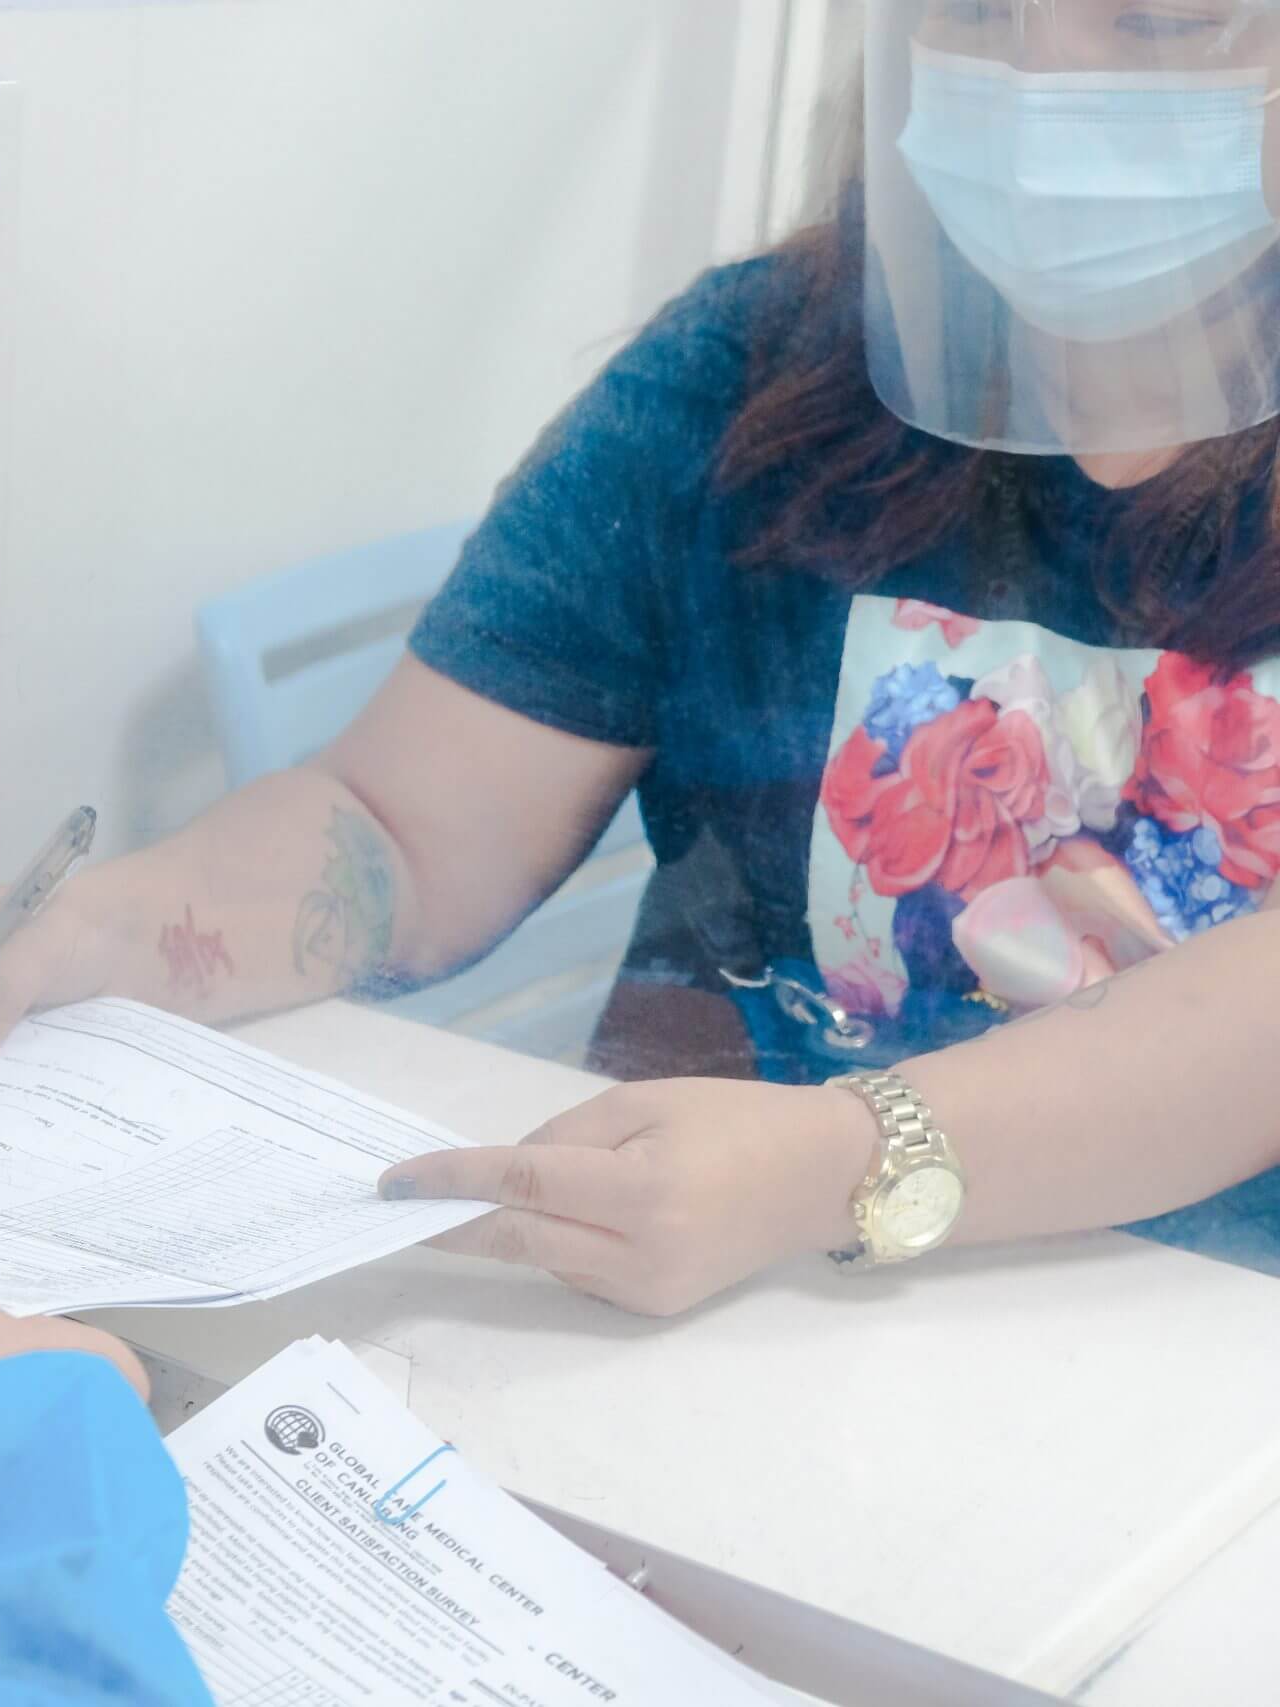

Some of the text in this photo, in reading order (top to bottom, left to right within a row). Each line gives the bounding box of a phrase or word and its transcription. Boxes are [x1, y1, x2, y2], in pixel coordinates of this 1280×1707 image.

[314, 1452, 337, 1468] OF
[295, 1479, 339, 1517] CLIENT
[338, 1517, 426, 1587] SATISFACTION
[426, 1586, 480, 1627] SURVEY
[329, 1442, 380, 1490] GLOBAL
[423, 1521, 485, 1573] MEDICAL
[488, 1574, 544, 1617] CENTER
[544, 1652, 617, 1703] CENTER
